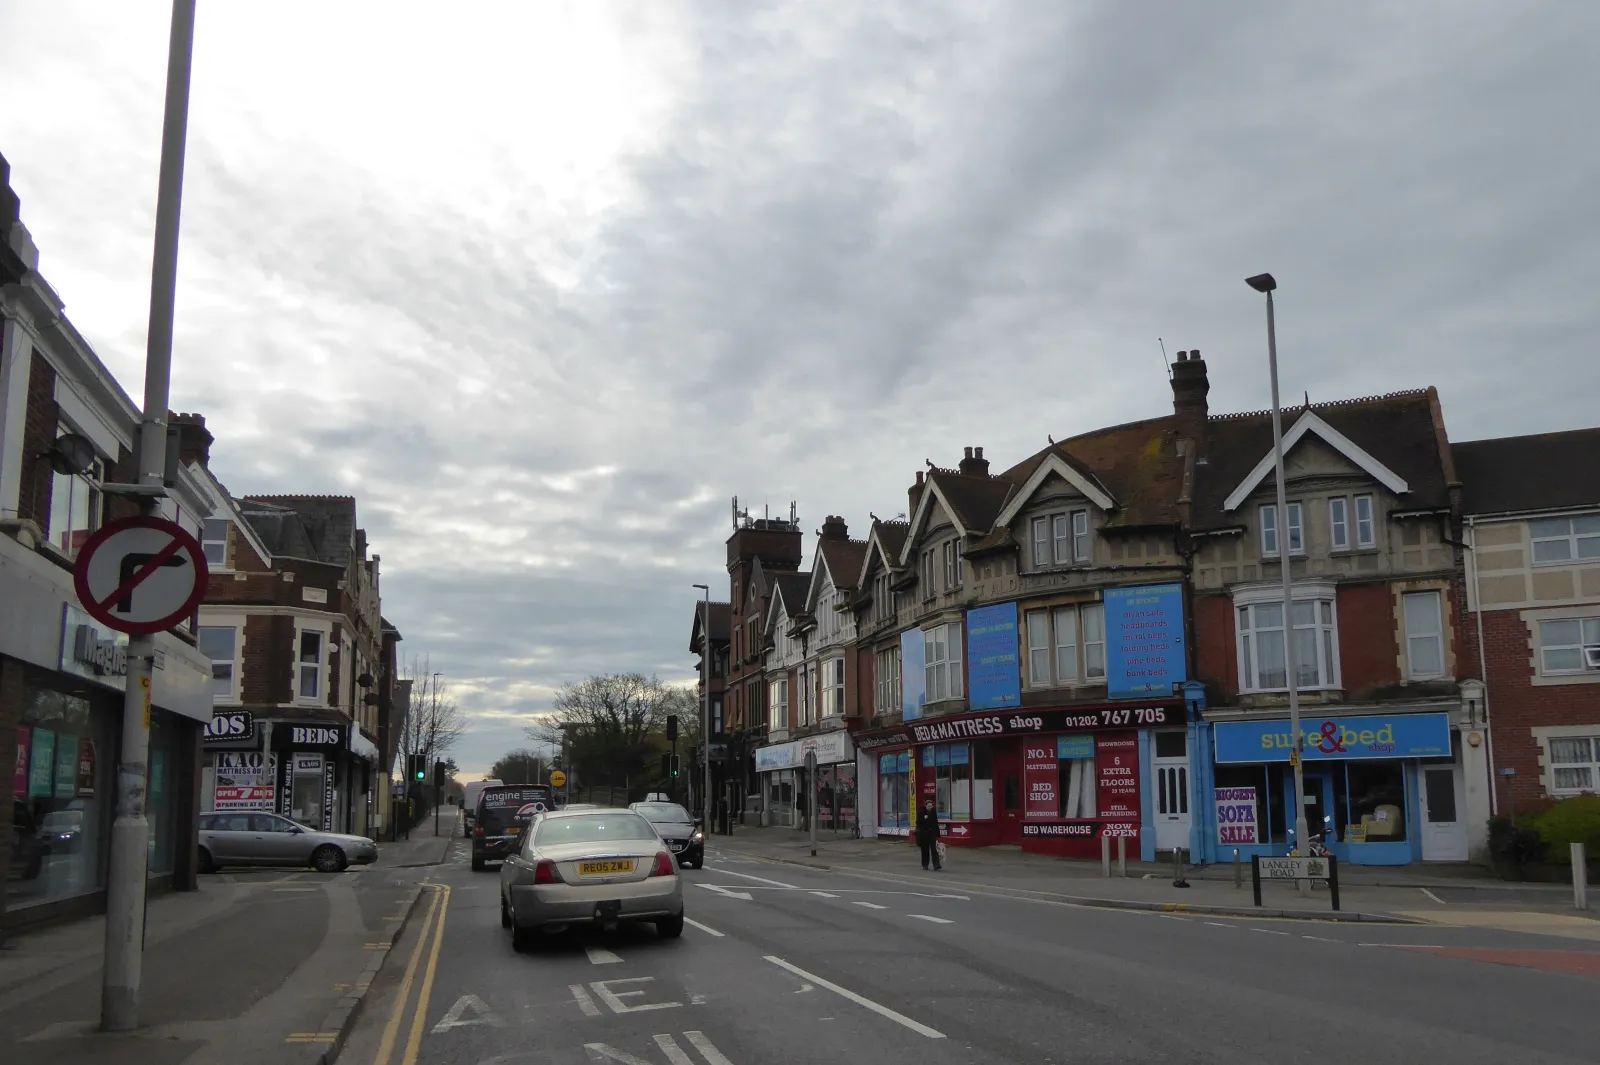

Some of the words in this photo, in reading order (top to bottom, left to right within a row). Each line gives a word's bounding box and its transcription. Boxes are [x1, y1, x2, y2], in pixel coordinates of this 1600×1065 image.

[1121, 620, 1168, 630] headboards
[1148, 631, 1167, 639] beds
[74, 624, 128, 676] Magne
[1121, 644, 1149, 653] folding
[1150, 642, 1170, 651] beds
[1146, 656, 1166, 664] beds
[1126, 669, 1146, 677] bunk
[1149, 668, 1168, 676] beds
[1008, 715, 1043, 730] shop
[1065, 717, 1098, 728] 01202
[1101, 710, 1131, 726] 767
[1135, 708, 1166, 724] 705
[204, 715, 245, 736] OS
[292, 727, 339, 744] BEDS
[1369, 744, 1395, 752] shop
[1028, 749, 1046, 758] NO.
[1049, 749, 1054, 758] 1
[1114, 756, 1120, 765] 6
[1032, 783, 1052, 792] BED
[1100, 779, 1135, 787] FLOORS
[237, 788, 253, 799] 7
[325, 766, 333, 814] FACTORY
[1215, 789, 1255, 801] BIGGEST
[485, 792, 520, 802] engine
[1029, 793, 1055, 801] SHOP
[1218, 805, 1255, 823] SOFA
[1024, 826, 1039, 834] BED
[1040, 826, 1091, 834] WAREHOUSE
[1102, 829, 1137, 837] OPEN
[1220, 826, 1255, 843] SALE
[583, 863, 608, 873] RE05
[1262, 861, 1301, 869] LANGLEY
